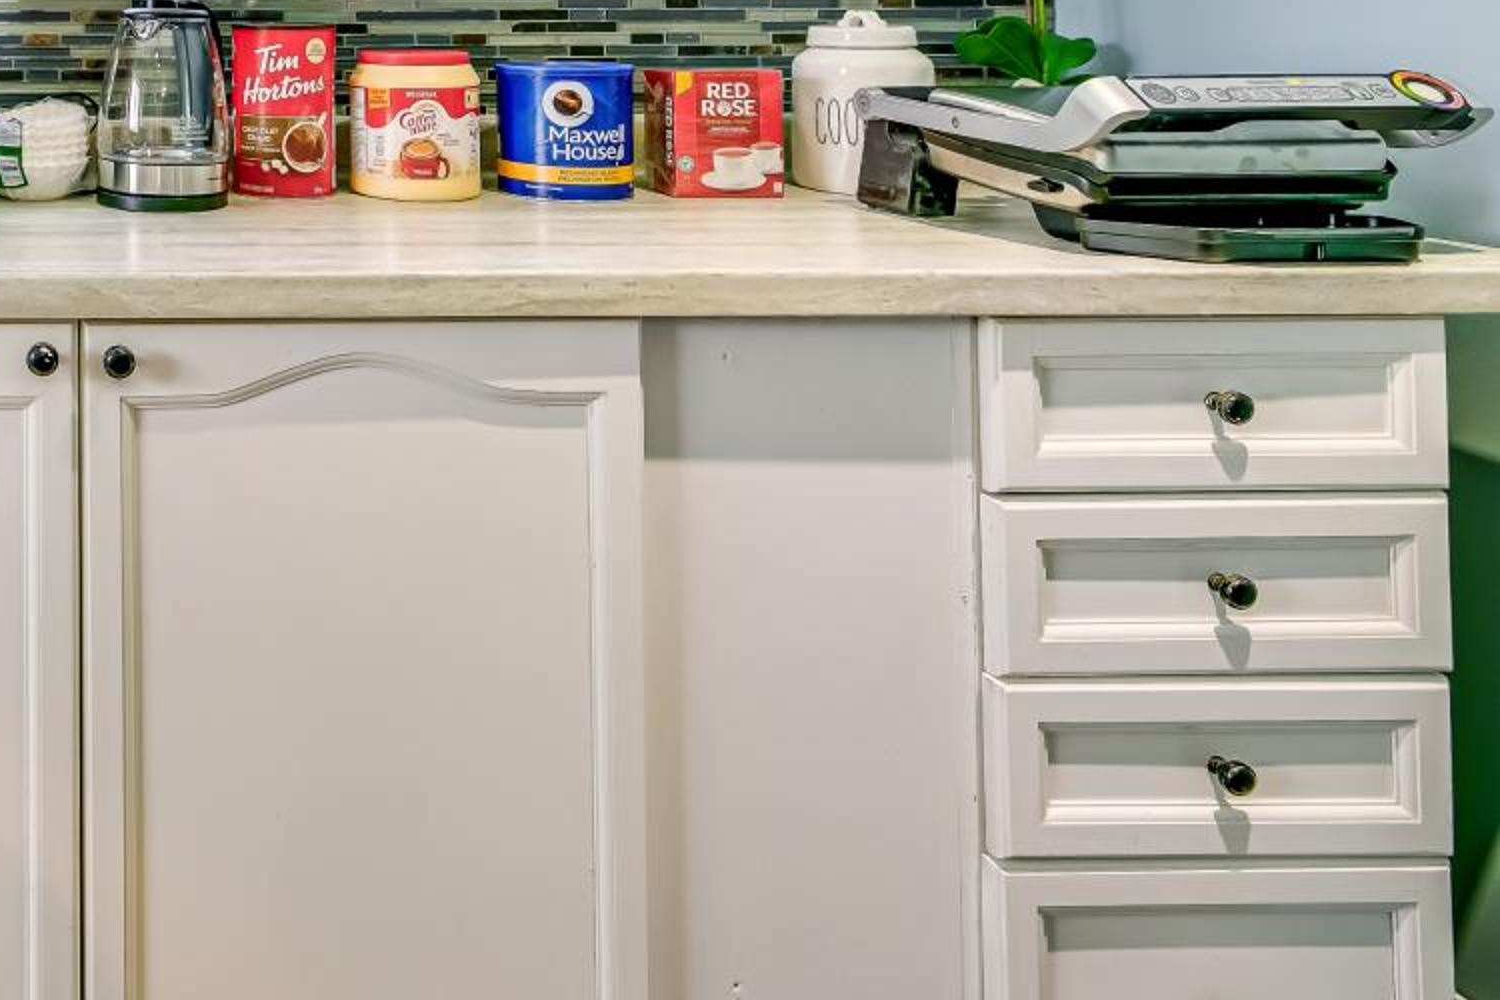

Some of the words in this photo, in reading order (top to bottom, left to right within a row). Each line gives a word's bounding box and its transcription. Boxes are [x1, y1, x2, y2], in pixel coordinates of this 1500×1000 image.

[254, 43, 300, 75] Tim
[243, 75, 325, 105] Hortons
[707, 82, 751, 99] RED
[701, 99, 759, 117] ROSE
[547, 123, 625, 147] Maxwell
[552, 143, 618, 161] House
